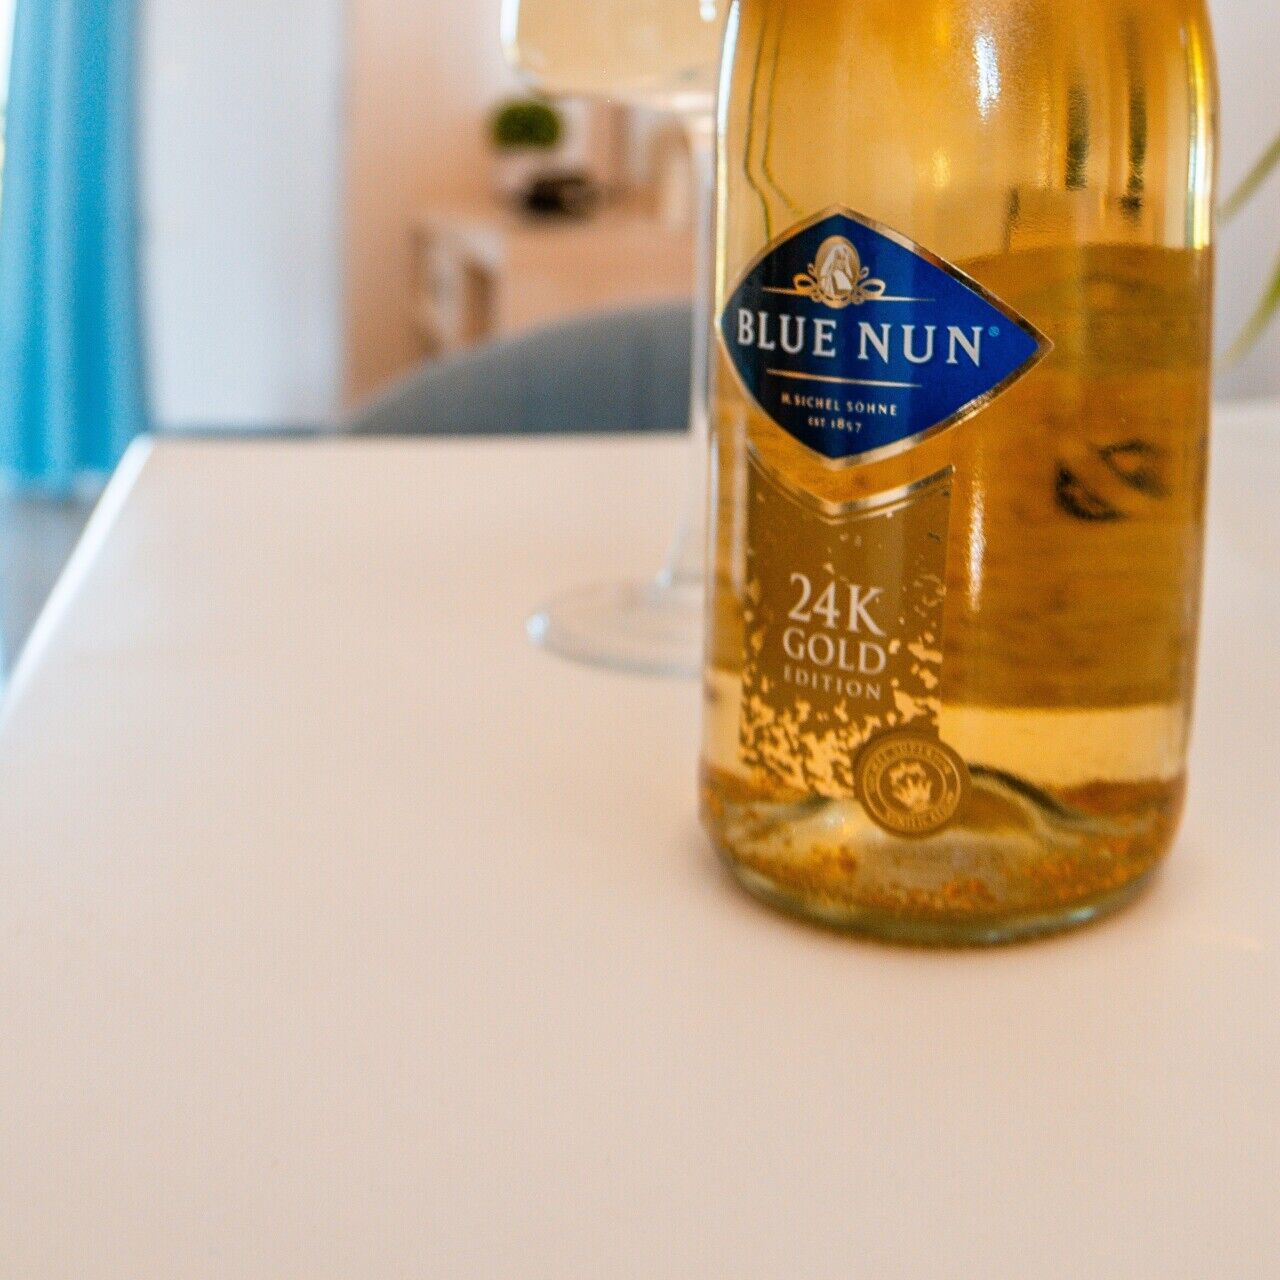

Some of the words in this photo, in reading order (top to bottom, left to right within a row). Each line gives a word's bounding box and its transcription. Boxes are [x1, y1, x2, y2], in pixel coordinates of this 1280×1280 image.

[737, 308, 837, 357] BLUE
[788, 572, 887, 638] 24K
[782, 626, 887, 675] GOLD
[783, 664, 881, 700] EDITION
